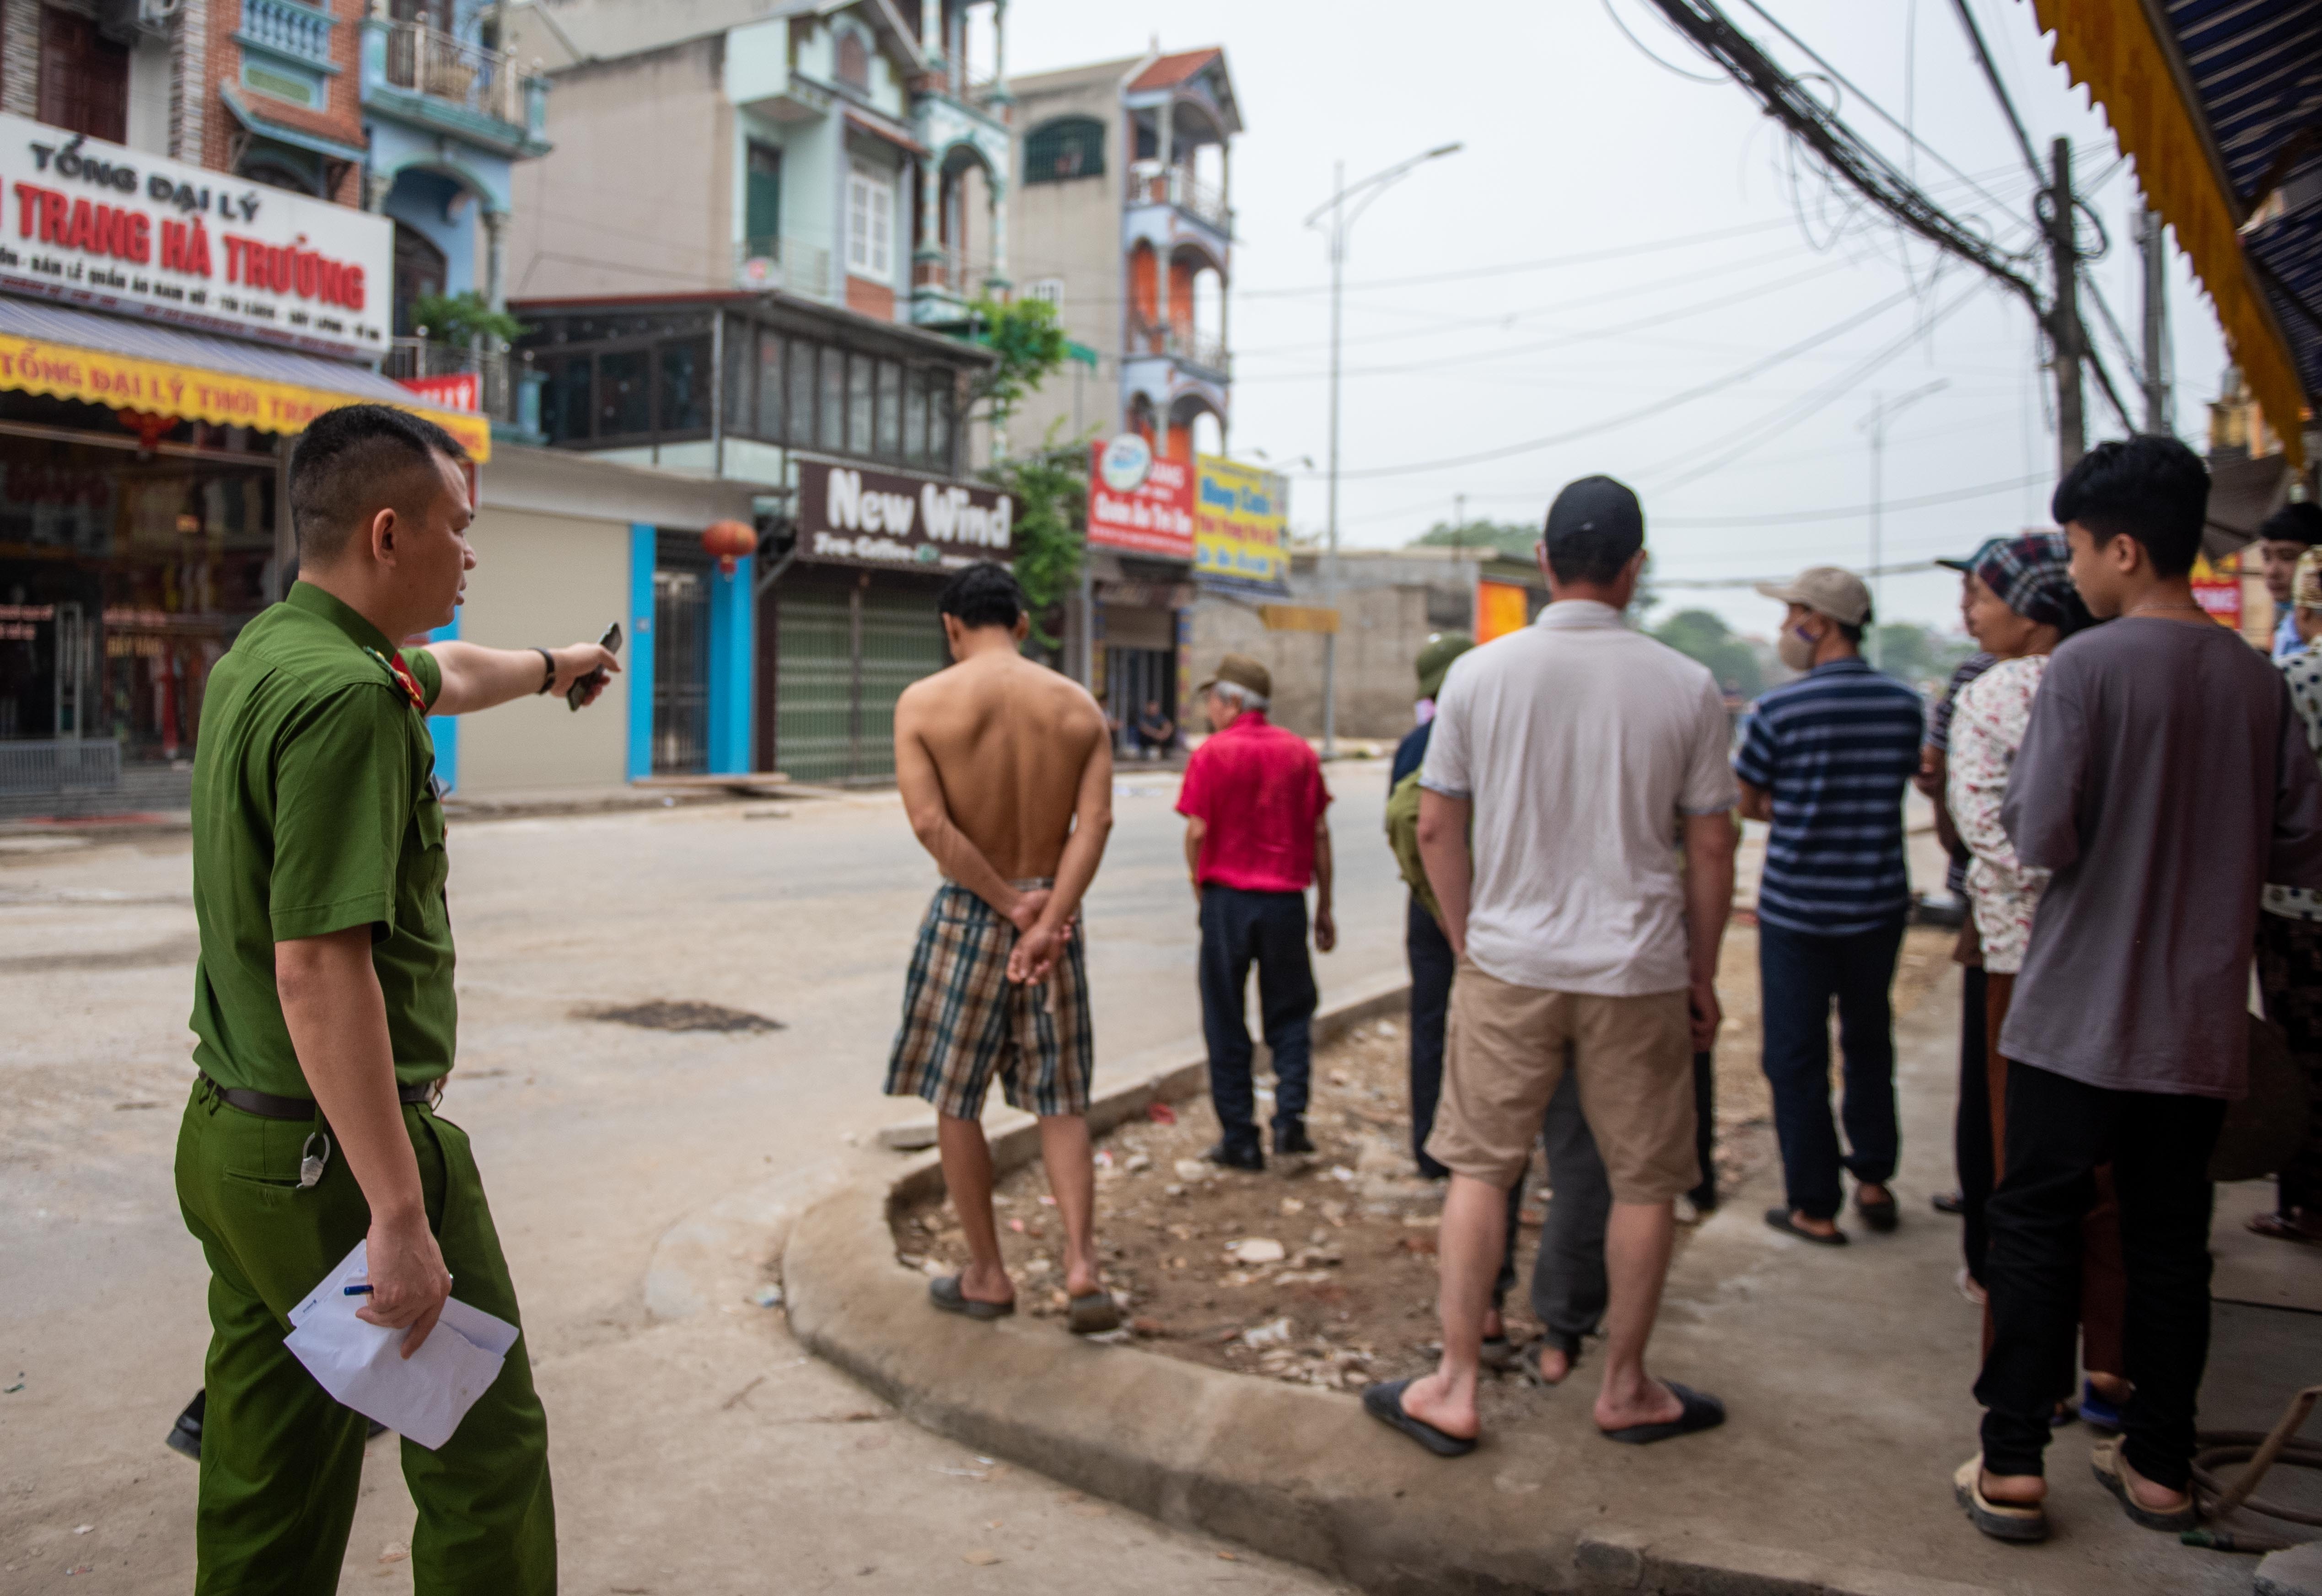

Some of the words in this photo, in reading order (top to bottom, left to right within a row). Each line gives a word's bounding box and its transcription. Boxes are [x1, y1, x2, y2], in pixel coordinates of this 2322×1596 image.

[220, 188, 260, 223] LÝ
[15, 183, 151, 263] TRANG
[161, 214, 212, 278] HÀ
[223, 233, 365, 311] TRƯỞNG
[151, 373, 183, 406] LÝ
[827, 468, 915, 537] New
[920, 483, 1012, 549] Wind
